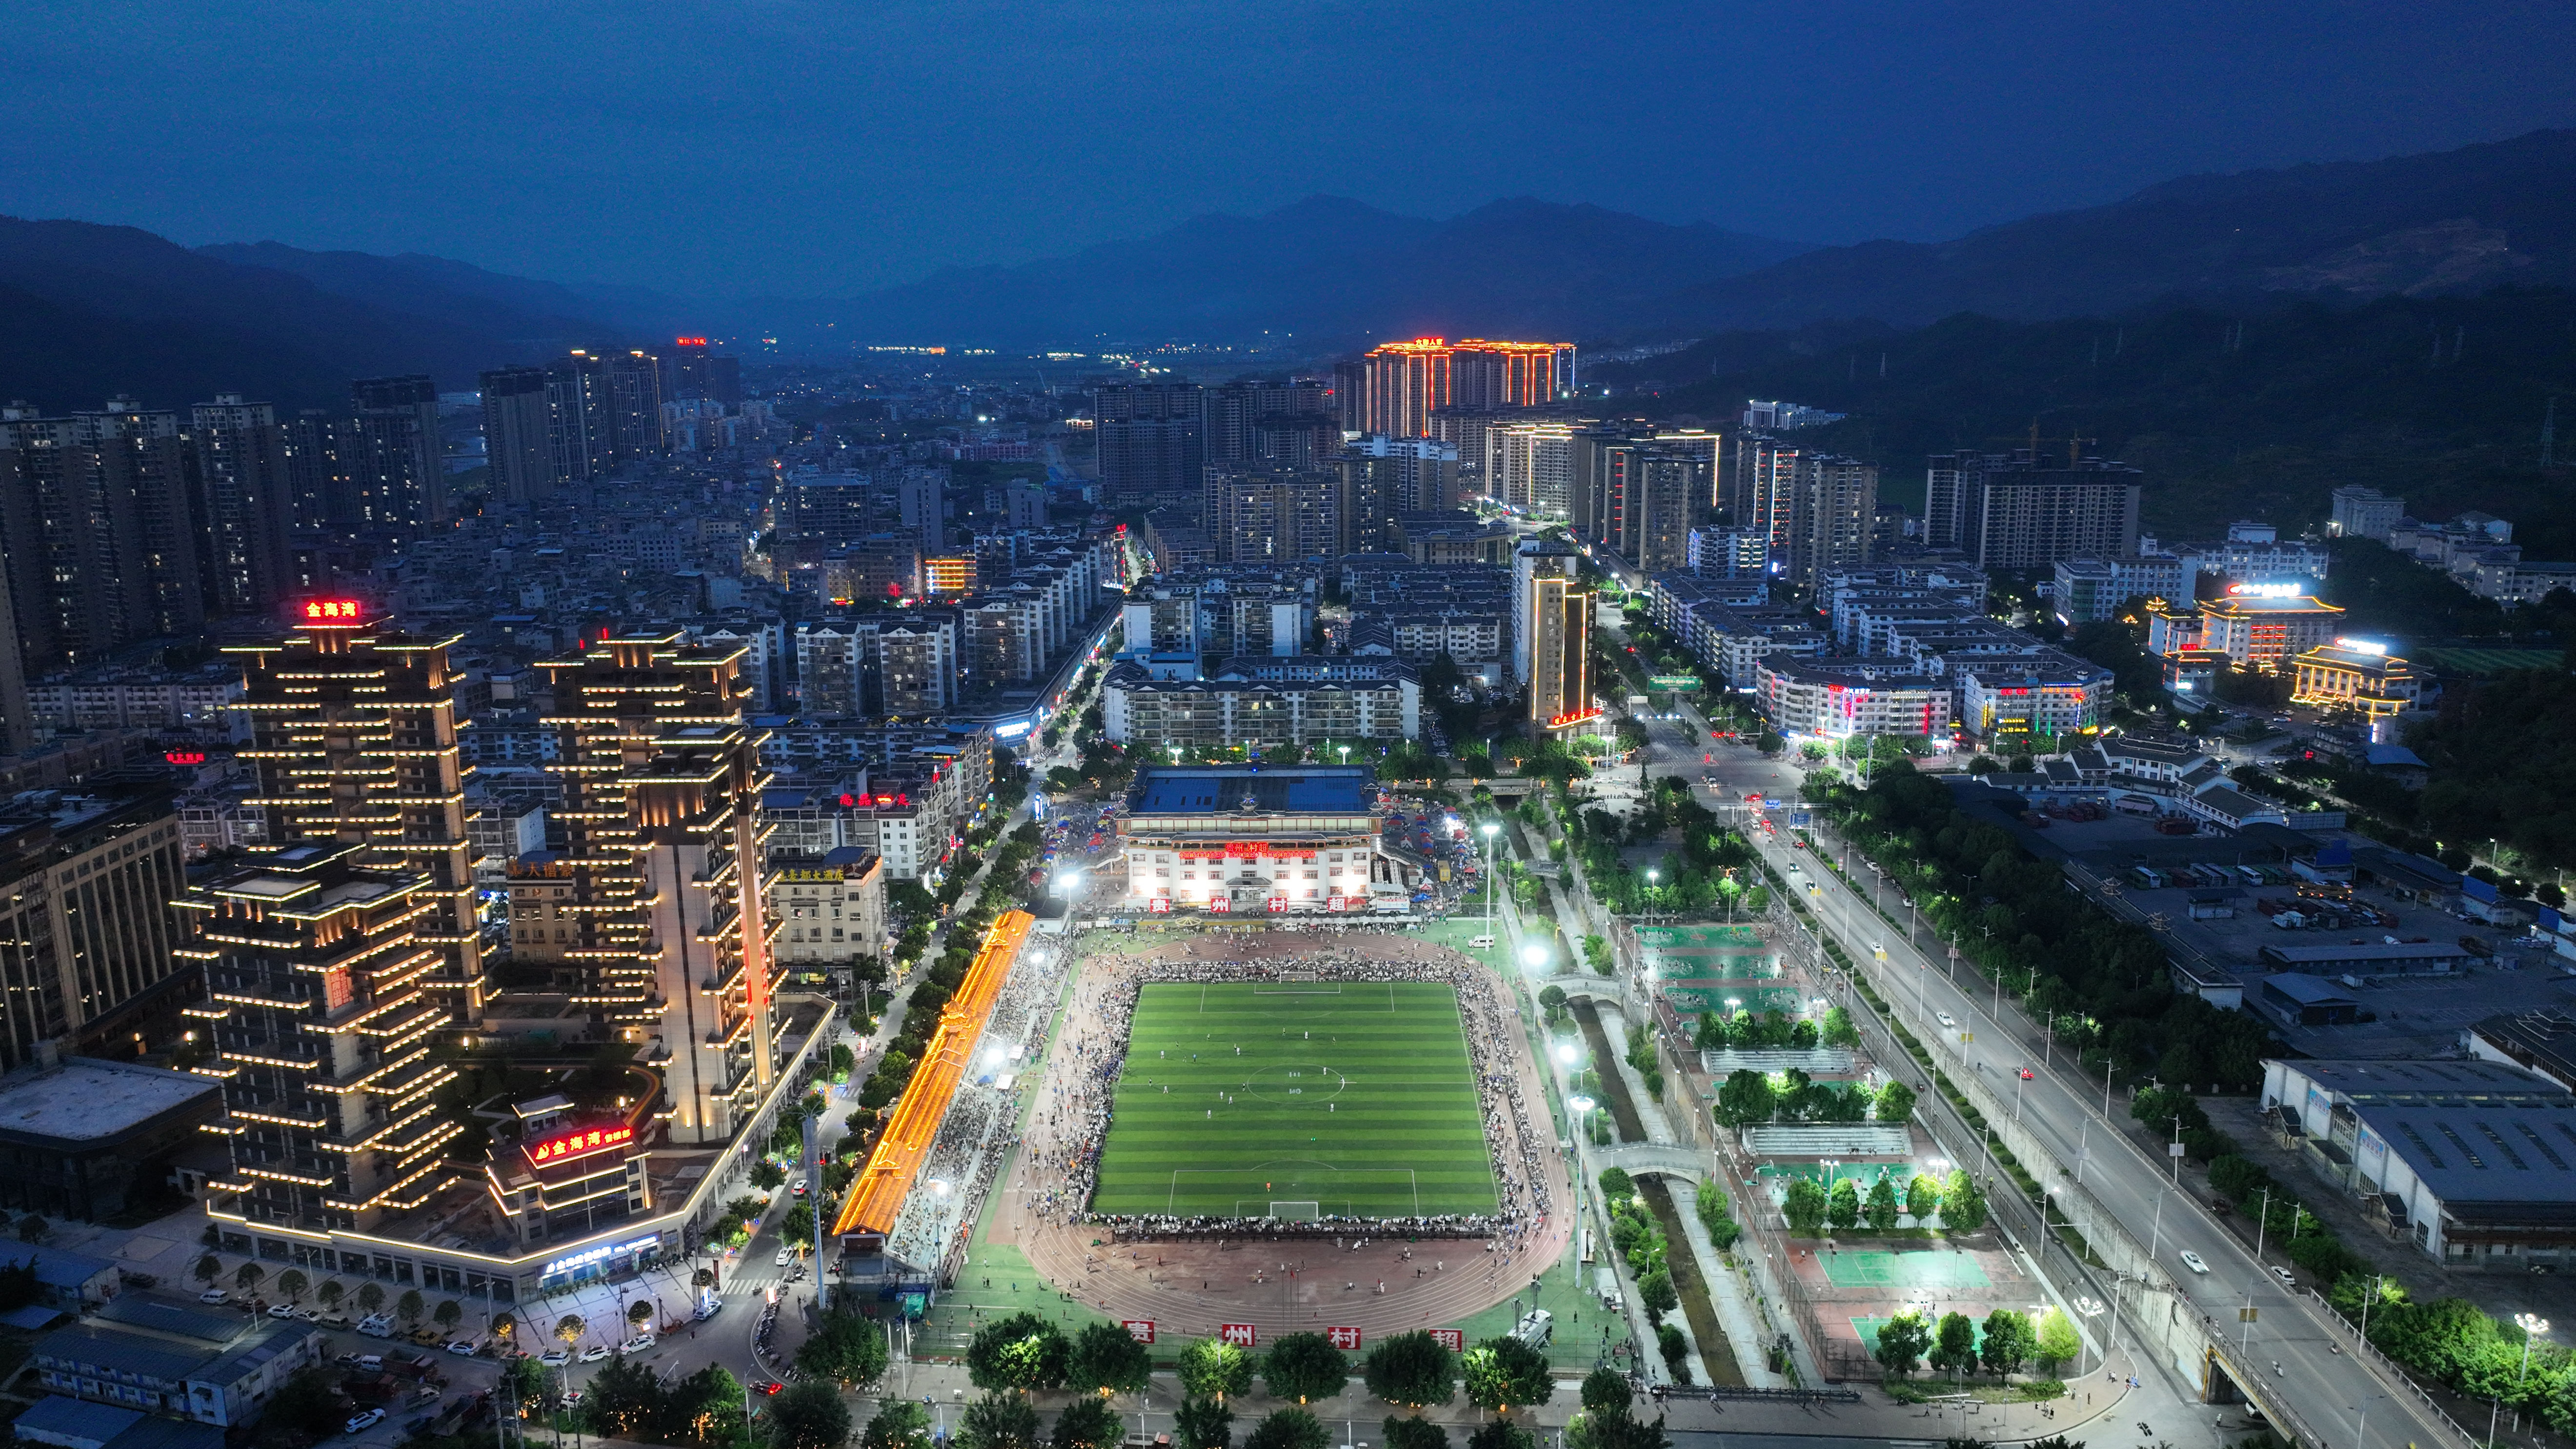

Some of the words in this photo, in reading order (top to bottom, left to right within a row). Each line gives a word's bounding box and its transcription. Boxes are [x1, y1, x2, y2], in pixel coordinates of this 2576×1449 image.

[306, 602, 356, 617] 金海湾
[1226, 843, 1244, 852] 贵州
[1248, 843, 1268, 853] 村超
[1151, 899, 1169, 912] 贵
[1212, 898, 1229, 912] 州
[1269, 897, 1287, 911] 村
[1328, 898, 1346, 911] 超
[1127, 1322, 1152, 1342] 贵
[1225, 1326, 1252, 1346] 州
[1330, 1328, 1359, 1348] 村
[1432, 1330, 1460, 1351] 超
